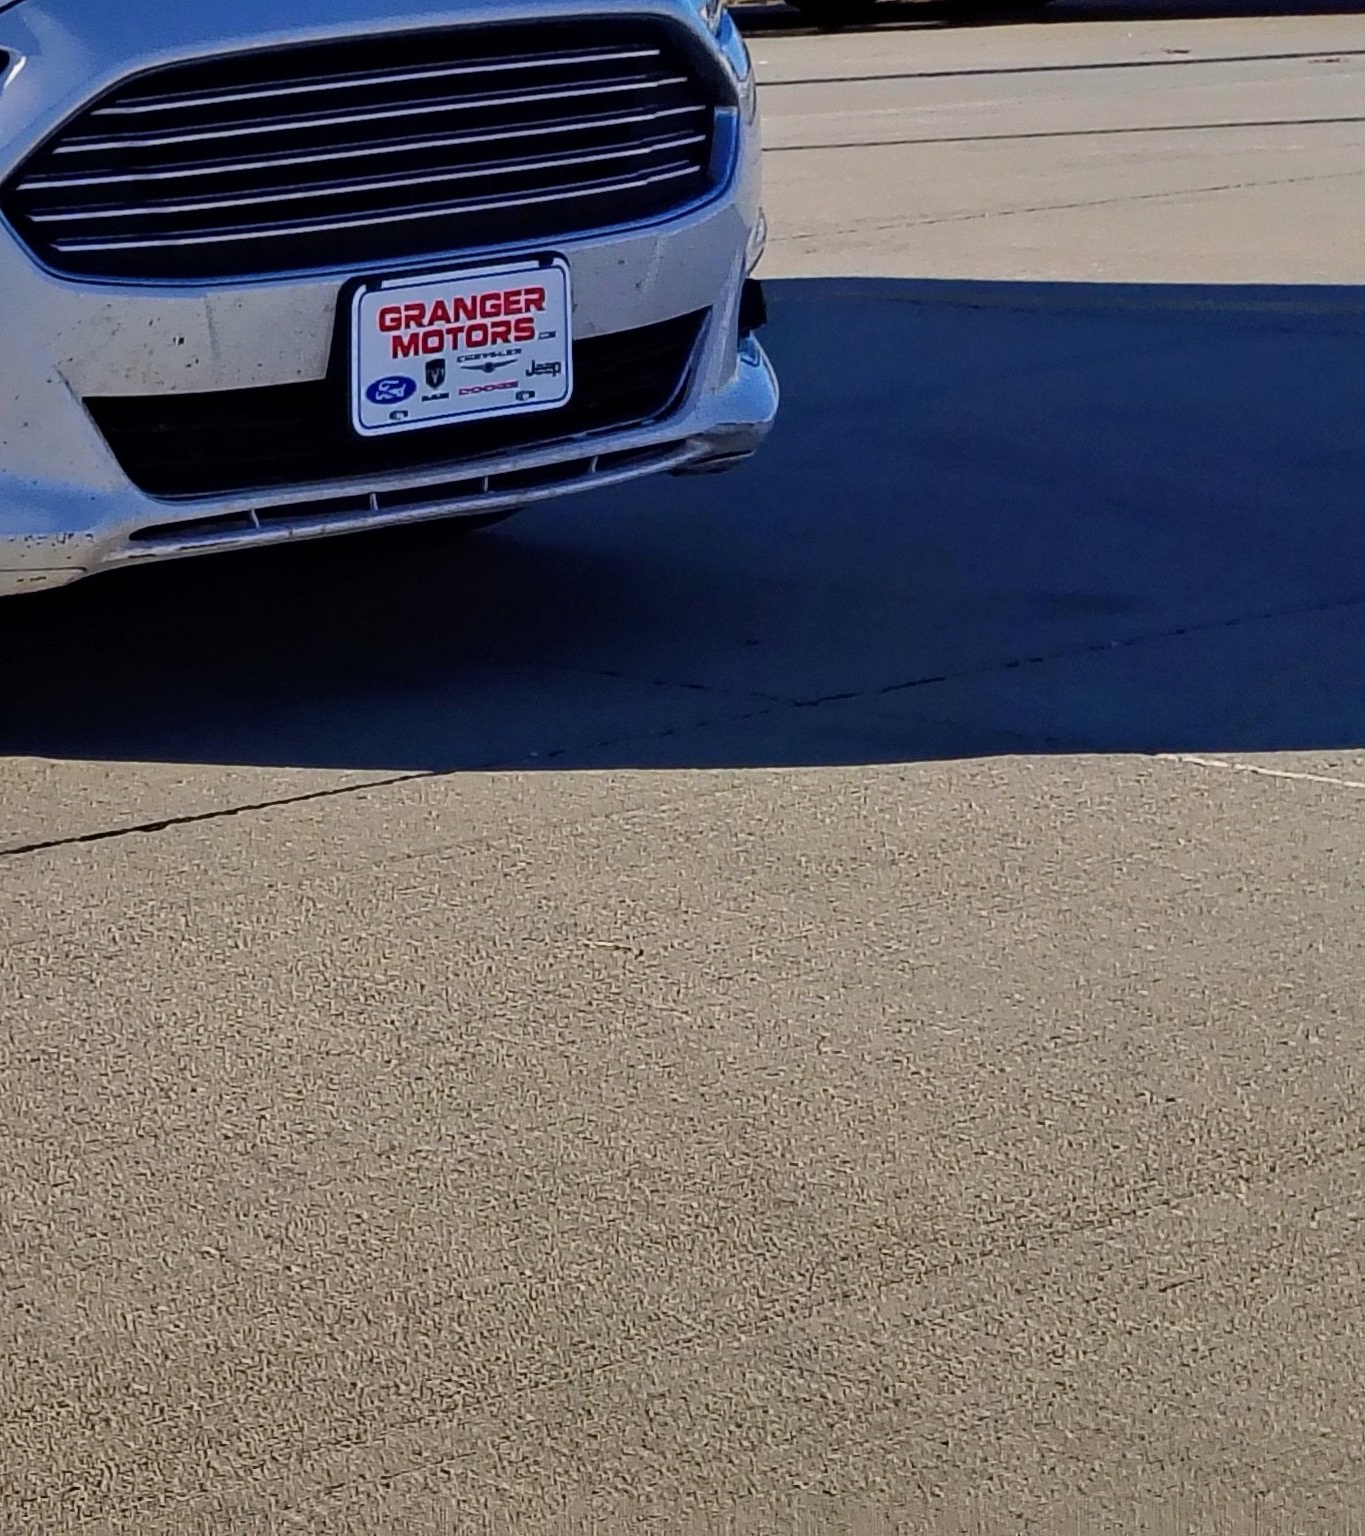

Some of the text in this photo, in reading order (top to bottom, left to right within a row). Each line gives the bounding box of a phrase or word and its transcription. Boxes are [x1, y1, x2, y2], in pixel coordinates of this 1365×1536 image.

[378, 286, 547, 333] GRANGER
[391, 316, 536, 359] MOTORS
[525, 360, 562, 378] Jeep
